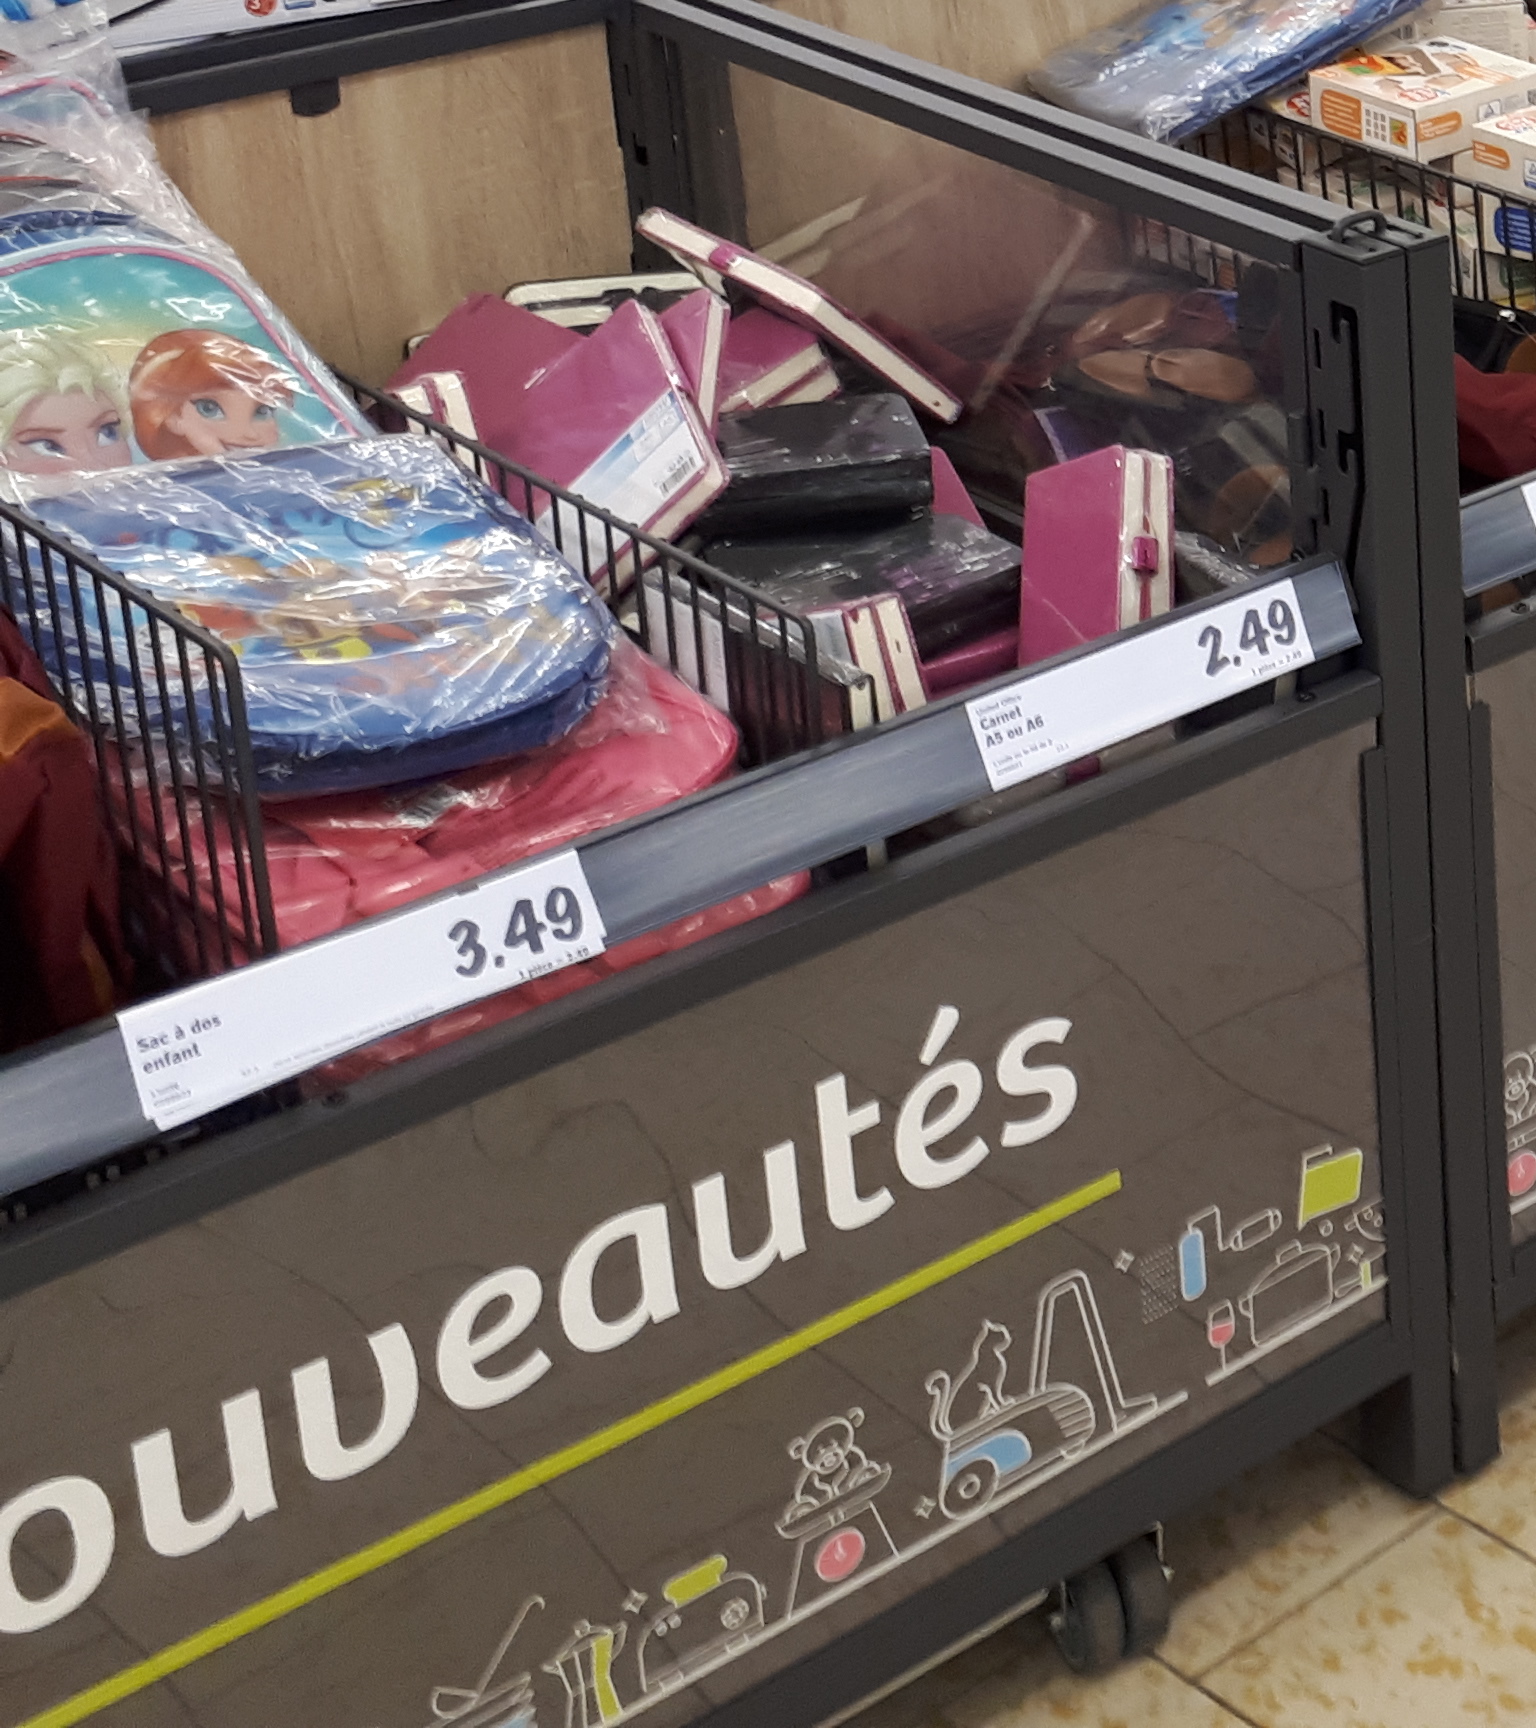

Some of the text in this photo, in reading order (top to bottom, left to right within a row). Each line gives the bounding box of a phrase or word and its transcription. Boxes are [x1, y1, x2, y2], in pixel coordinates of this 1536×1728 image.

[1197, 598, 1297, 678] 2.49
[979, 705, 1024, 732] Carnet
[984, 717, 1046, 749] A5 ou A6
[449, 885, 584, 978] 3.49
[136, 1011, 223, 1054] Sac à dos
[142, 1042, 202, 1075] enfant
[0, 1005, 1080, 1635] ouveautés
